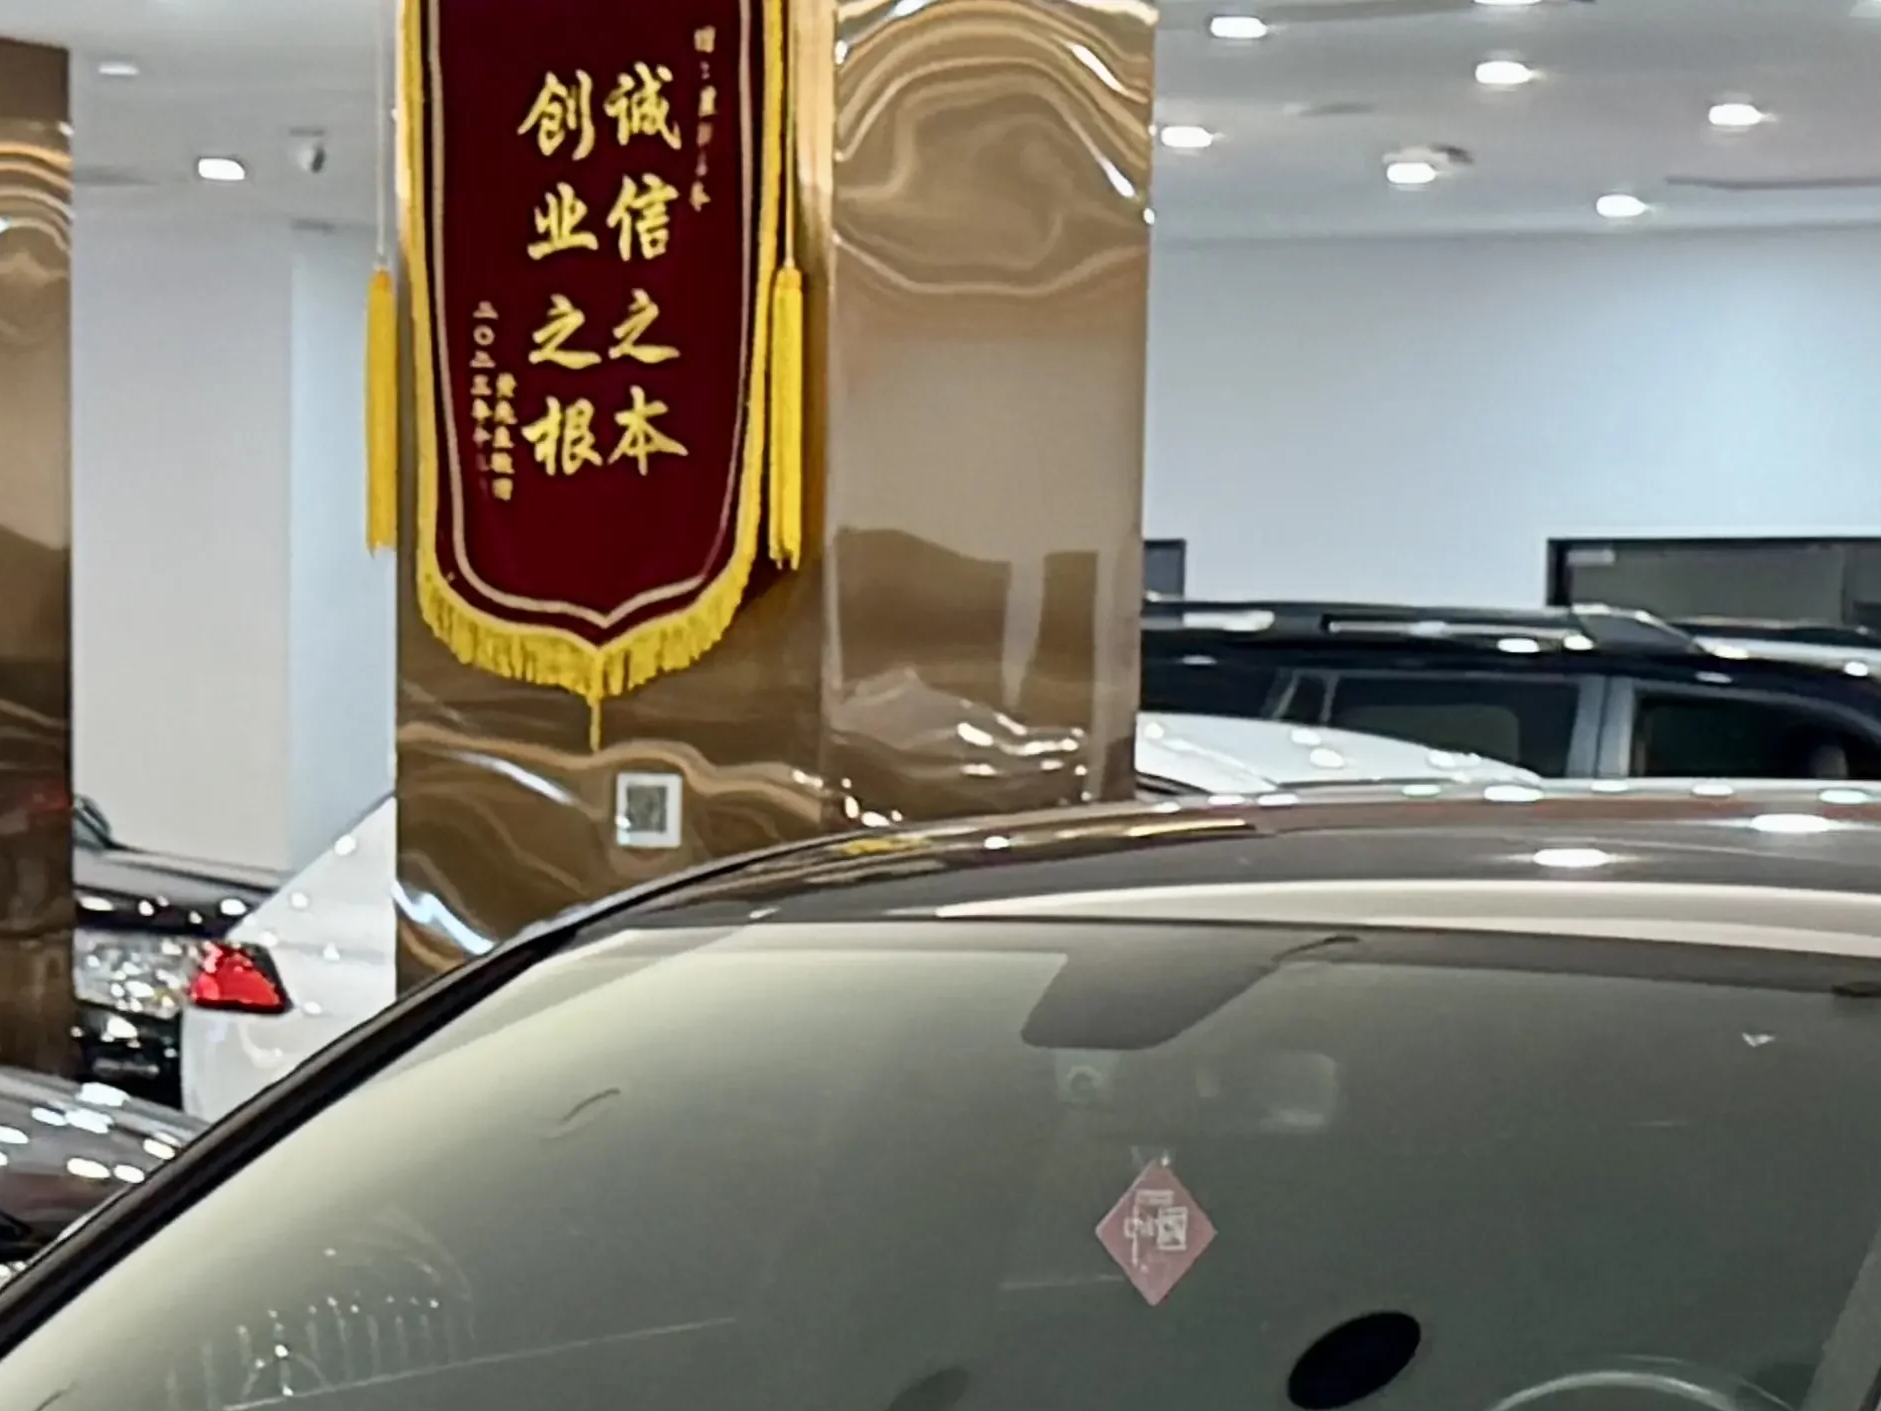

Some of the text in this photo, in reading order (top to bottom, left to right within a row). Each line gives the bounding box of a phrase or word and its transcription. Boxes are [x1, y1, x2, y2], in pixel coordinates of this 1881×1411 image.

[518, 69, 603, 476] 创业之根
[604, 62, 688, 476] 诚信之本
